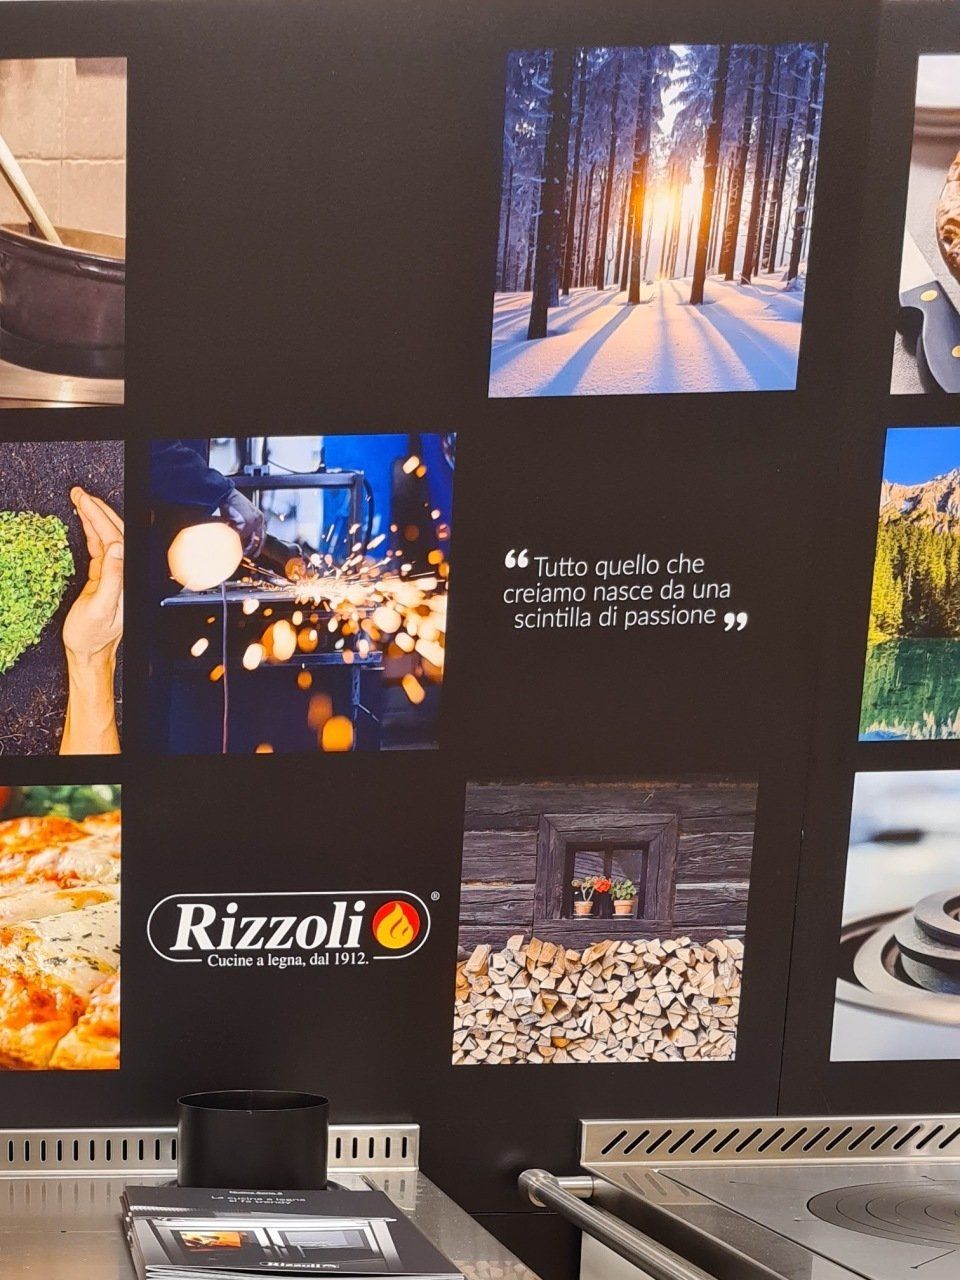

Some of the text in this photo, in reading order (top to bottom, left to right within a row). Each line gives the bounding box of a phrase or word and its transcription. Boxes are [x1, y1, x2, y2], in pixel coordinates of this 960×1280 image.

[534, 556, 588, 578] Tutto
[595, 553, 660, 580] quello
[666, 552, 705, 575] che
[503, 578, 731, 604] creiamo nasce da una
[514, 606, 591, 629] scintilla
[598, 605, 617, 627] di
[624, 604, 717, 631] passione
[169, 900, 366, 950] Rizzoli
[207, 952, 369, 969] Cucine a legna, dal 1912.
